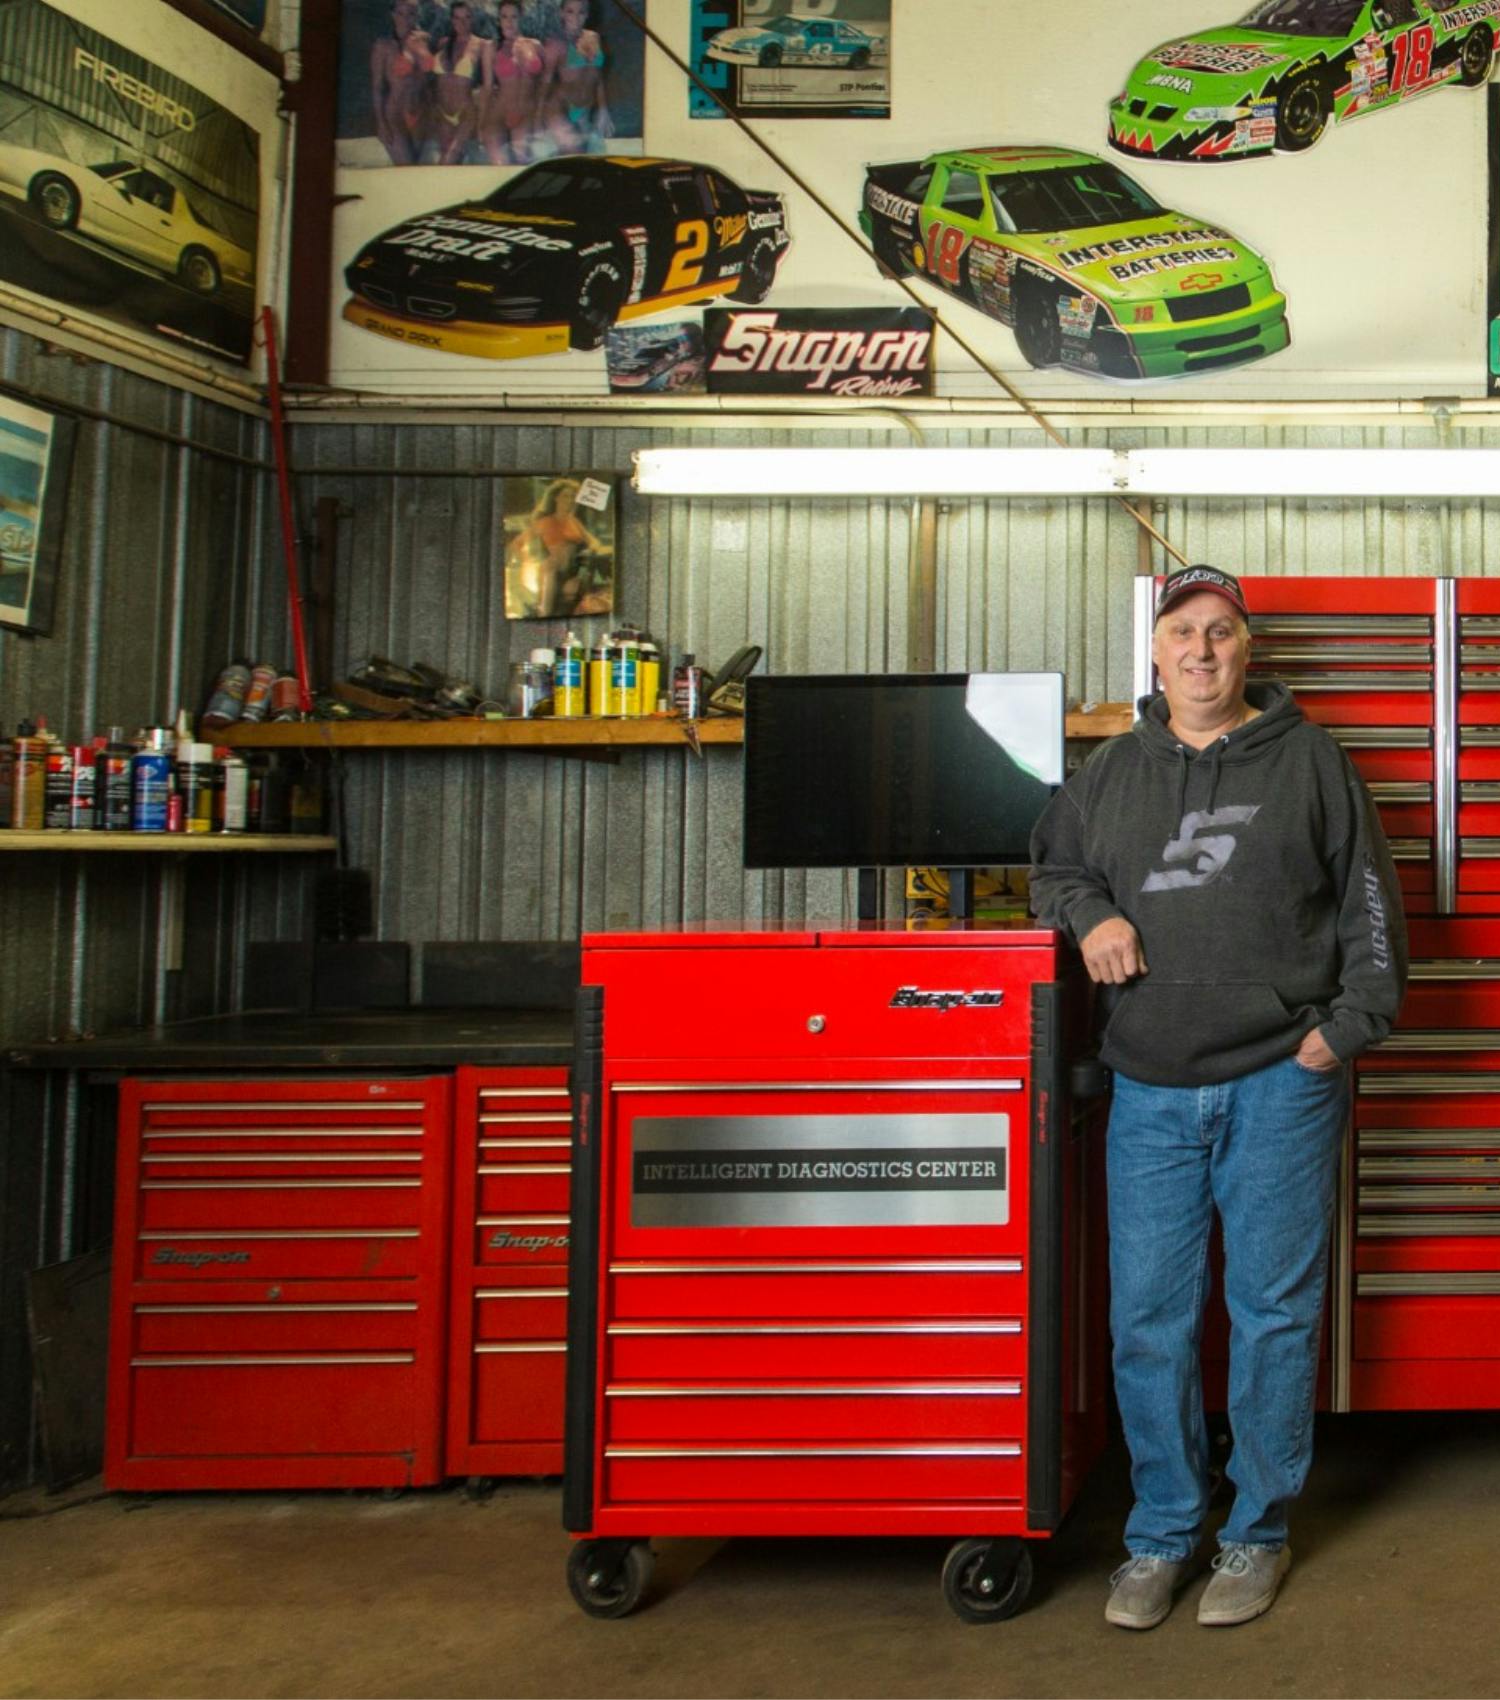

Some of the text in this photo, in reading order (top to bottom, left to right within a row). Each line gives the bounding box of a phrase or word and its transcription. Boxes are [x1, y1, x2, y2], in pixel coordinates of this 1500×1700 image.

[1391, 24, 1435, 92] 18
[75, 48, 196, 132] FIREBIRD
[383, 228, 512, 261] Draft
[661, 219, 710, 293] 2
[926, 220, 966, 285] 18
[1055, 228, 1233, 269] INTERSTATE
[1107, 246, 1238, 282] BATTERIES
[1134, 305, 1154, 322] 18
[710, 312, 932, 389] Snap-on
[831, 373, 922, 397] Racing
[889, 985, 1005, 1012] Snap-on
[643, 1161, 997, 1180] INTELLIGENT DIAGNOSTICS CENTER
[151, 1247, 251, 1269] Snap-on
[488, 1230, 571, 1253] Snap-o
